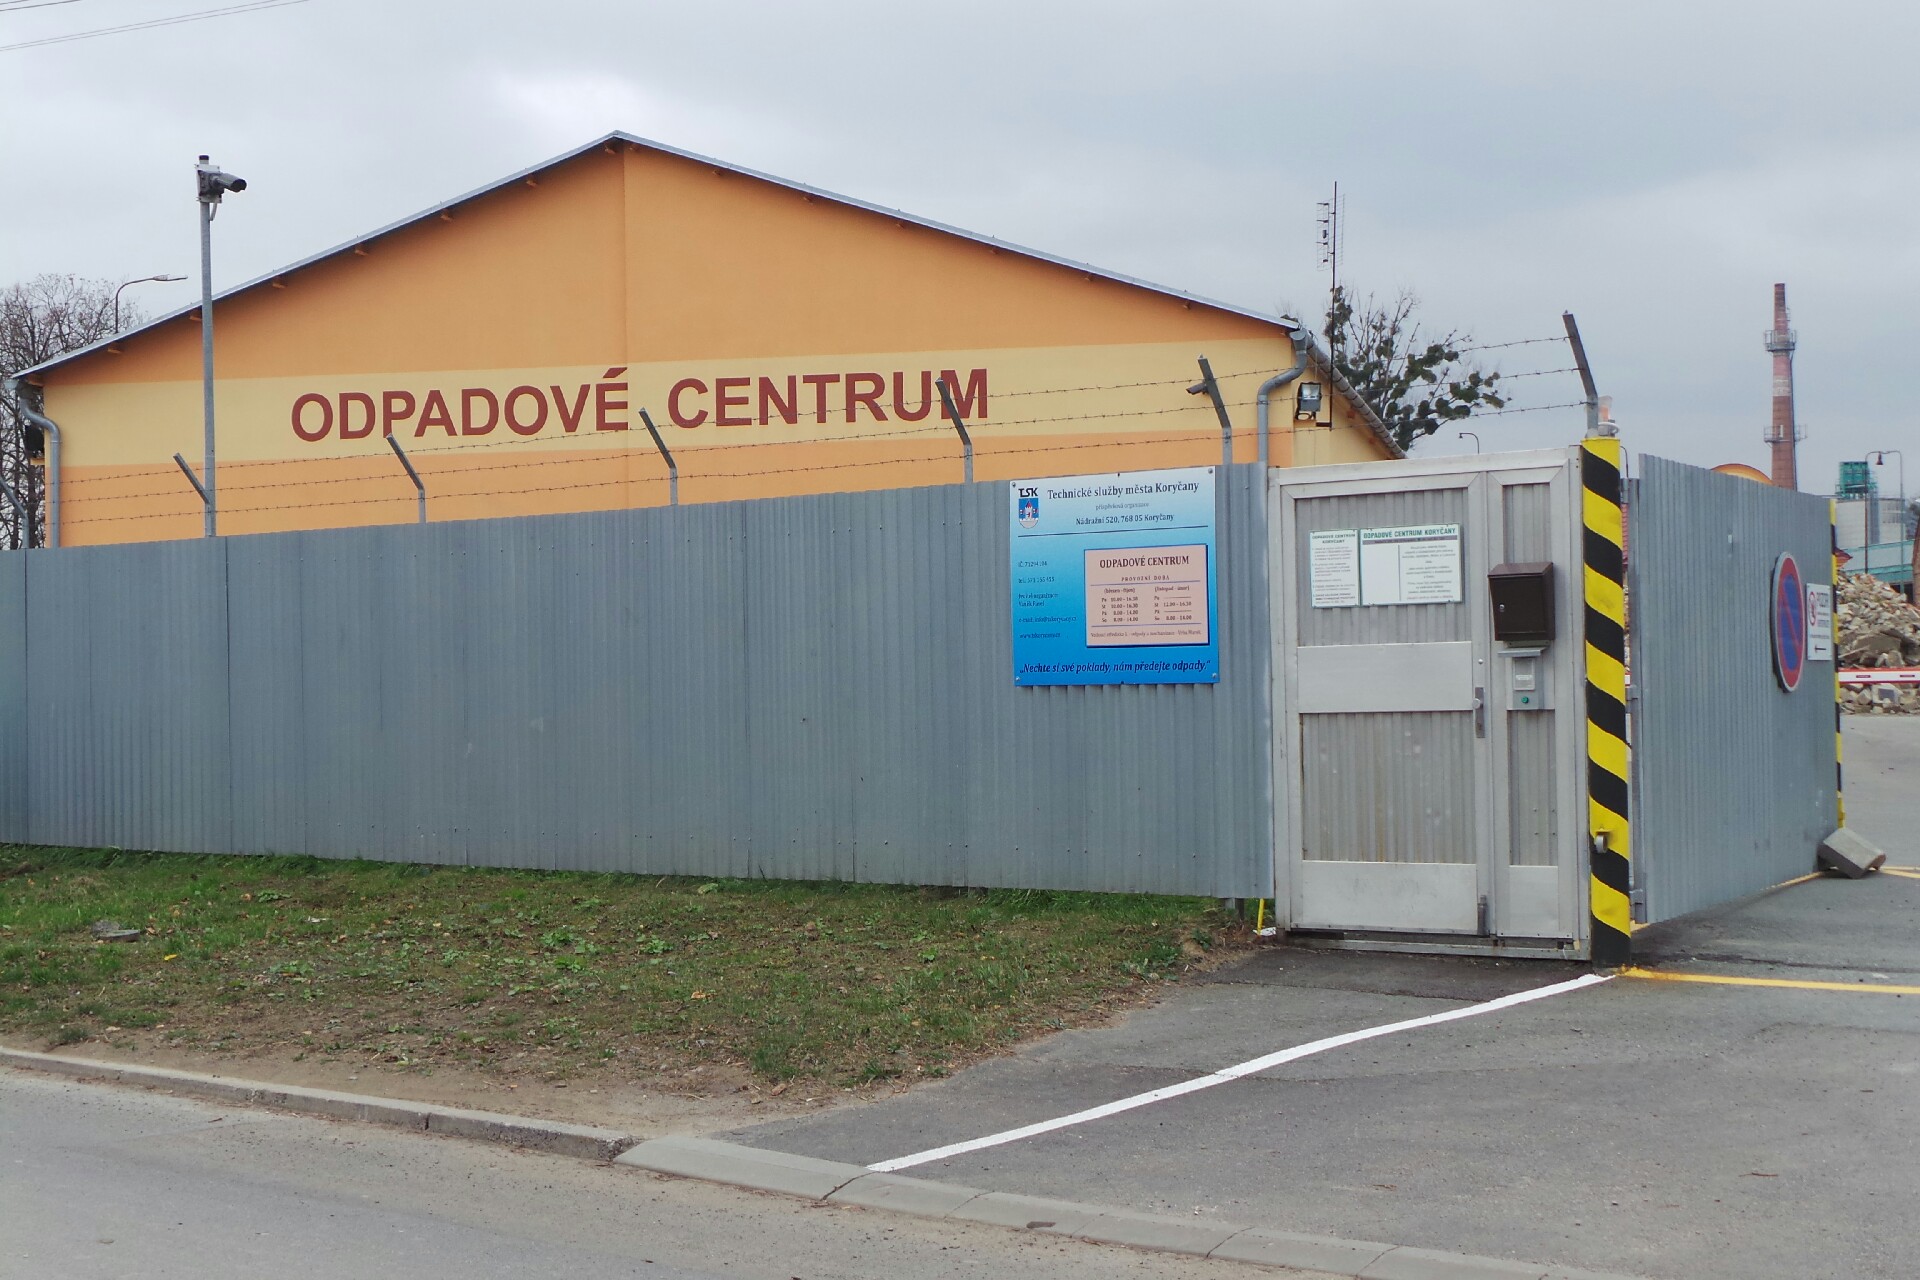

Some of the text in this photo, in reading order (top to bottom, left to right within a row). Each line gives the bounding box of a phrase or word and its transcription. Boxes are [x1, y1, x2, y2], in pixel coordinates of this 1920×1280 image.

[291, 366, 988, 442] ODPADOVÉ CENTRUM
[1047, 480, 1200, 499] Technické služby města Koryčany
[1076, 512, 1175, 525] Nádražní 520, 768 05 Koryčany
[1363, 526, 1456, 539] ODPADOVÉ CENTRUM KORYČANY
[1100, 555, 1189, 568] ODPADOVÉ CENTRUM
[1052, 663, 1060, 672] si
[1060, 662, 1074, 672] své
[1076, 662, 1111, 674] poklady,
[1113, 662, 1132, 672] nám
[1133, 661, 1170, 674] předejte
